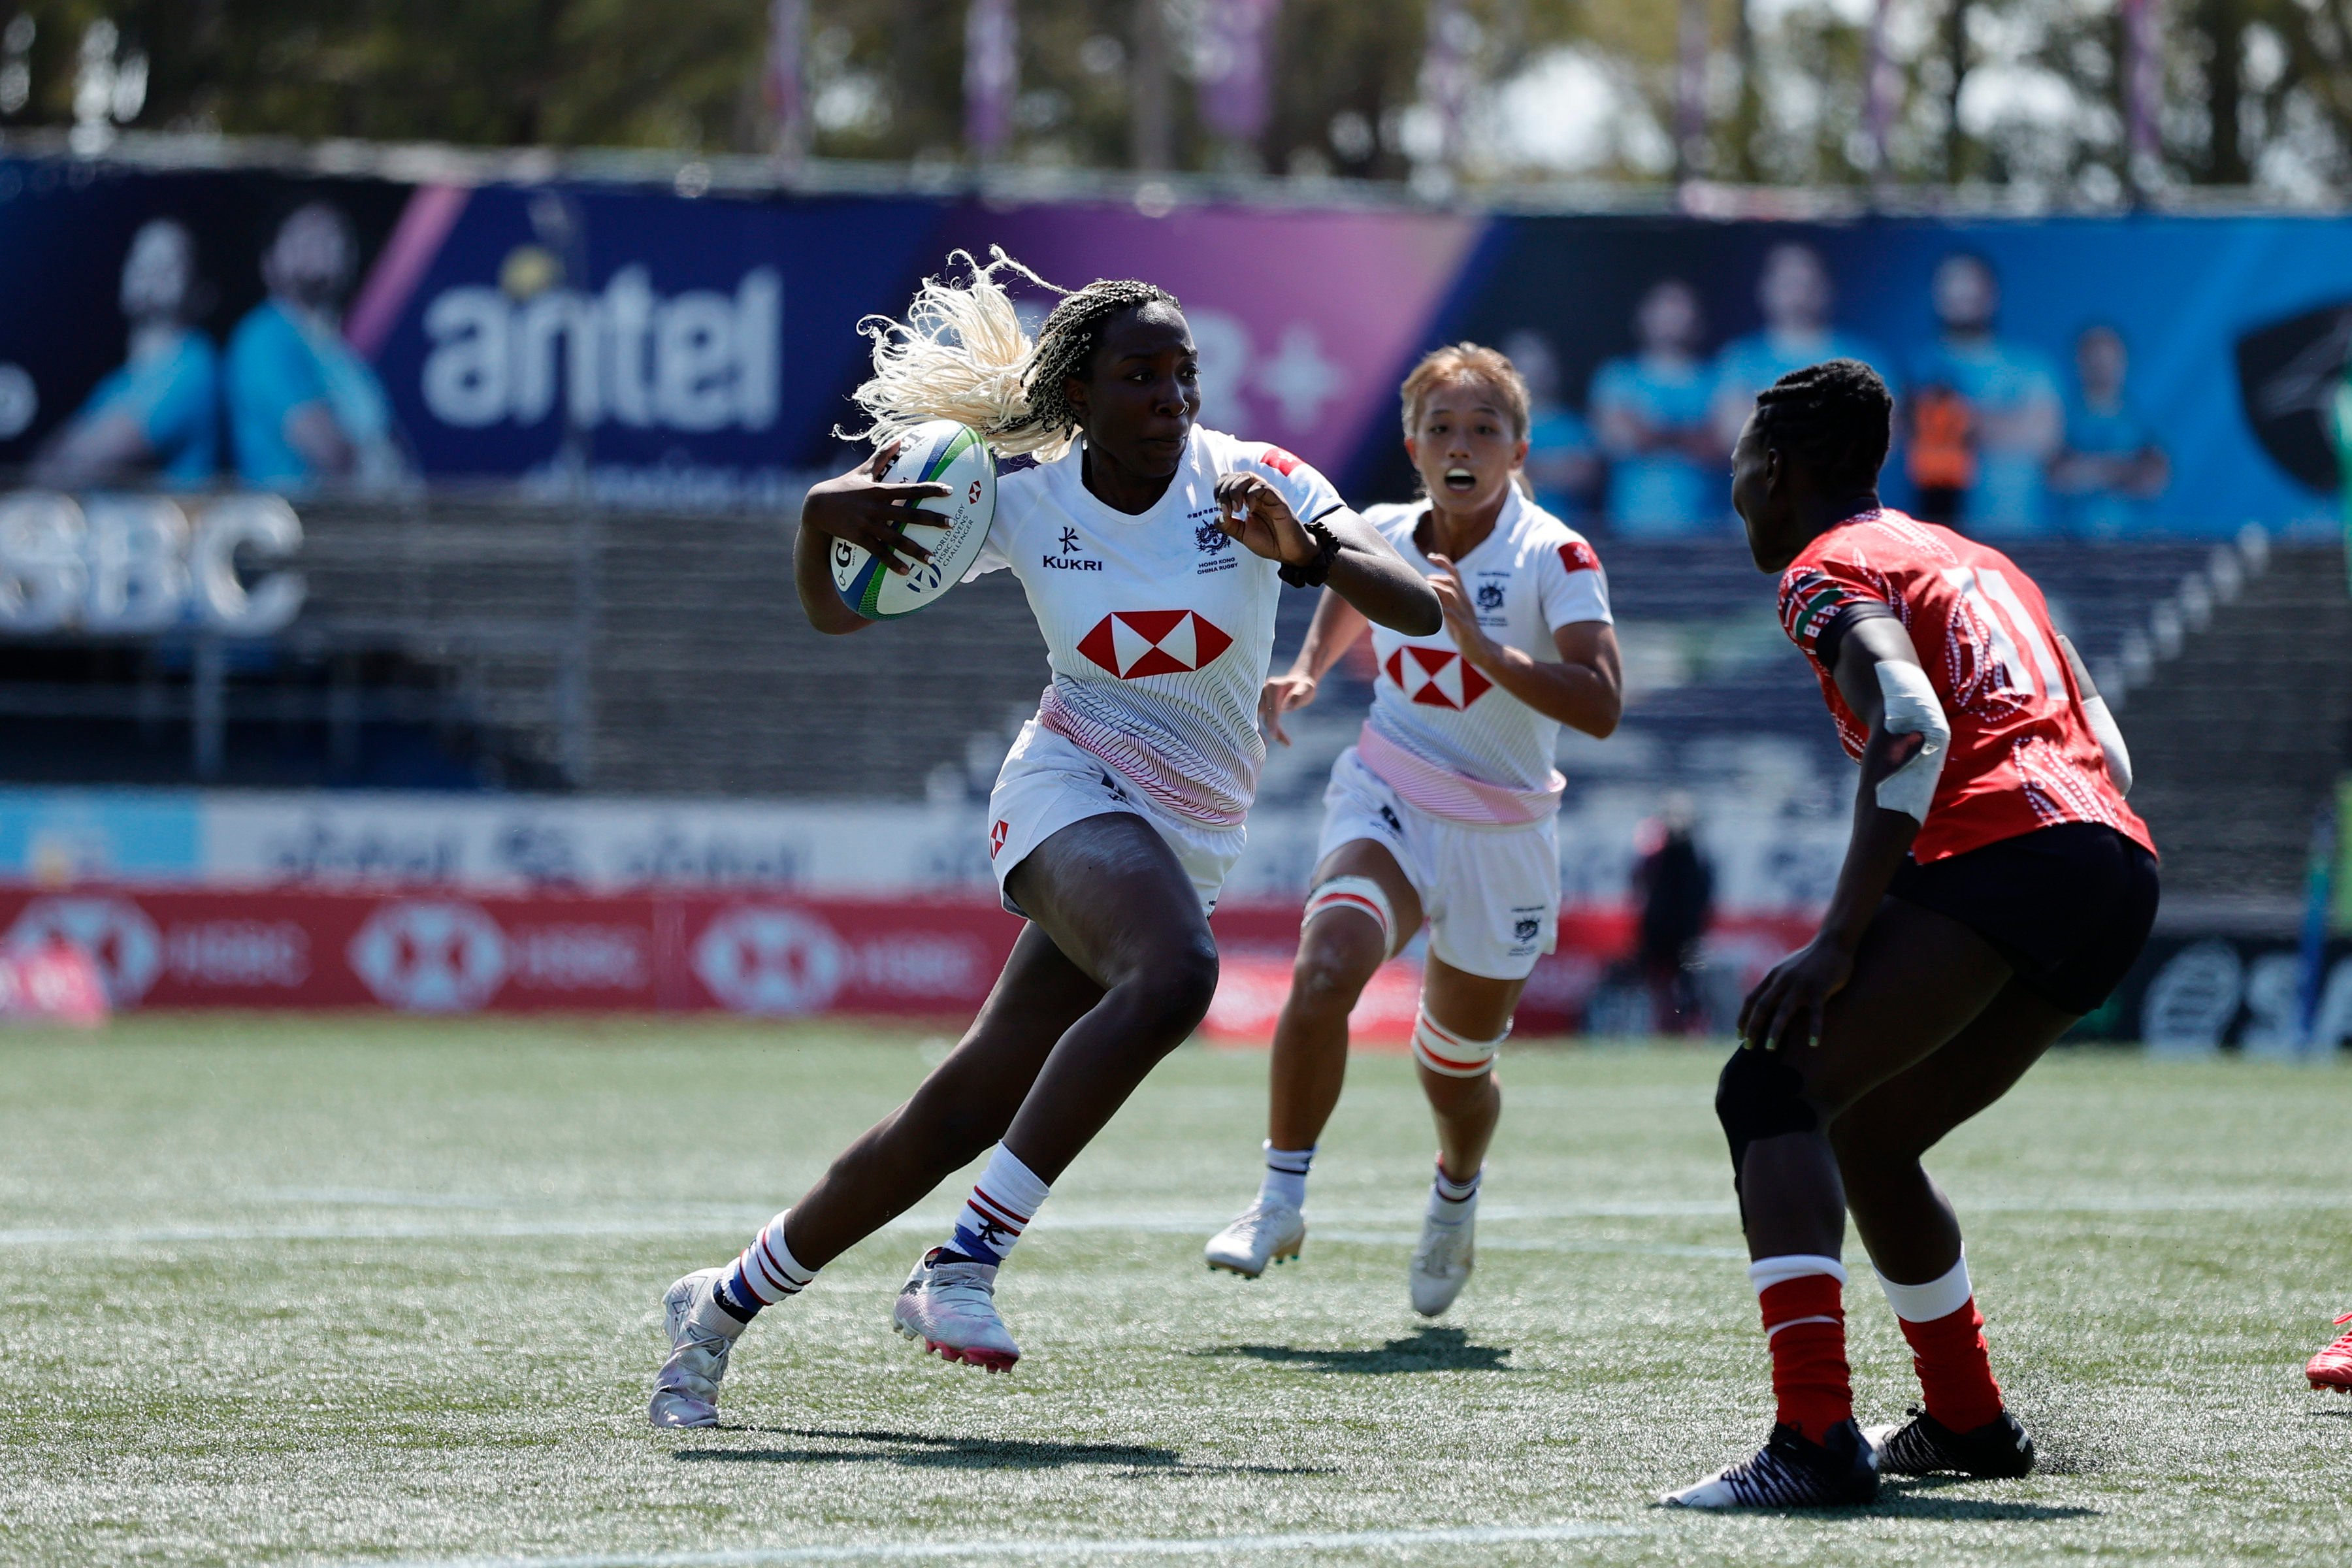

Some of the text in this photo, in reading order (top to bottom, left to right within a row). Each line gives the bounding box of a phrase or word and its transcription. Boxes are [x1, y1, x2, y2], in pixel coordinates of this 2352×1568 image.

[422, 264, 783, 431] antel
[932, 530, 952, 557] WORLD
[936, 514, 968, 563] HSBC SEVENS
[943, 519, 974, 567] CHALLENGER
[1043, 555, 1103, 571] KUKRI
[1197, 566, 1218, 575] CHINA
[1198, 560, 1218, 568] HONG
